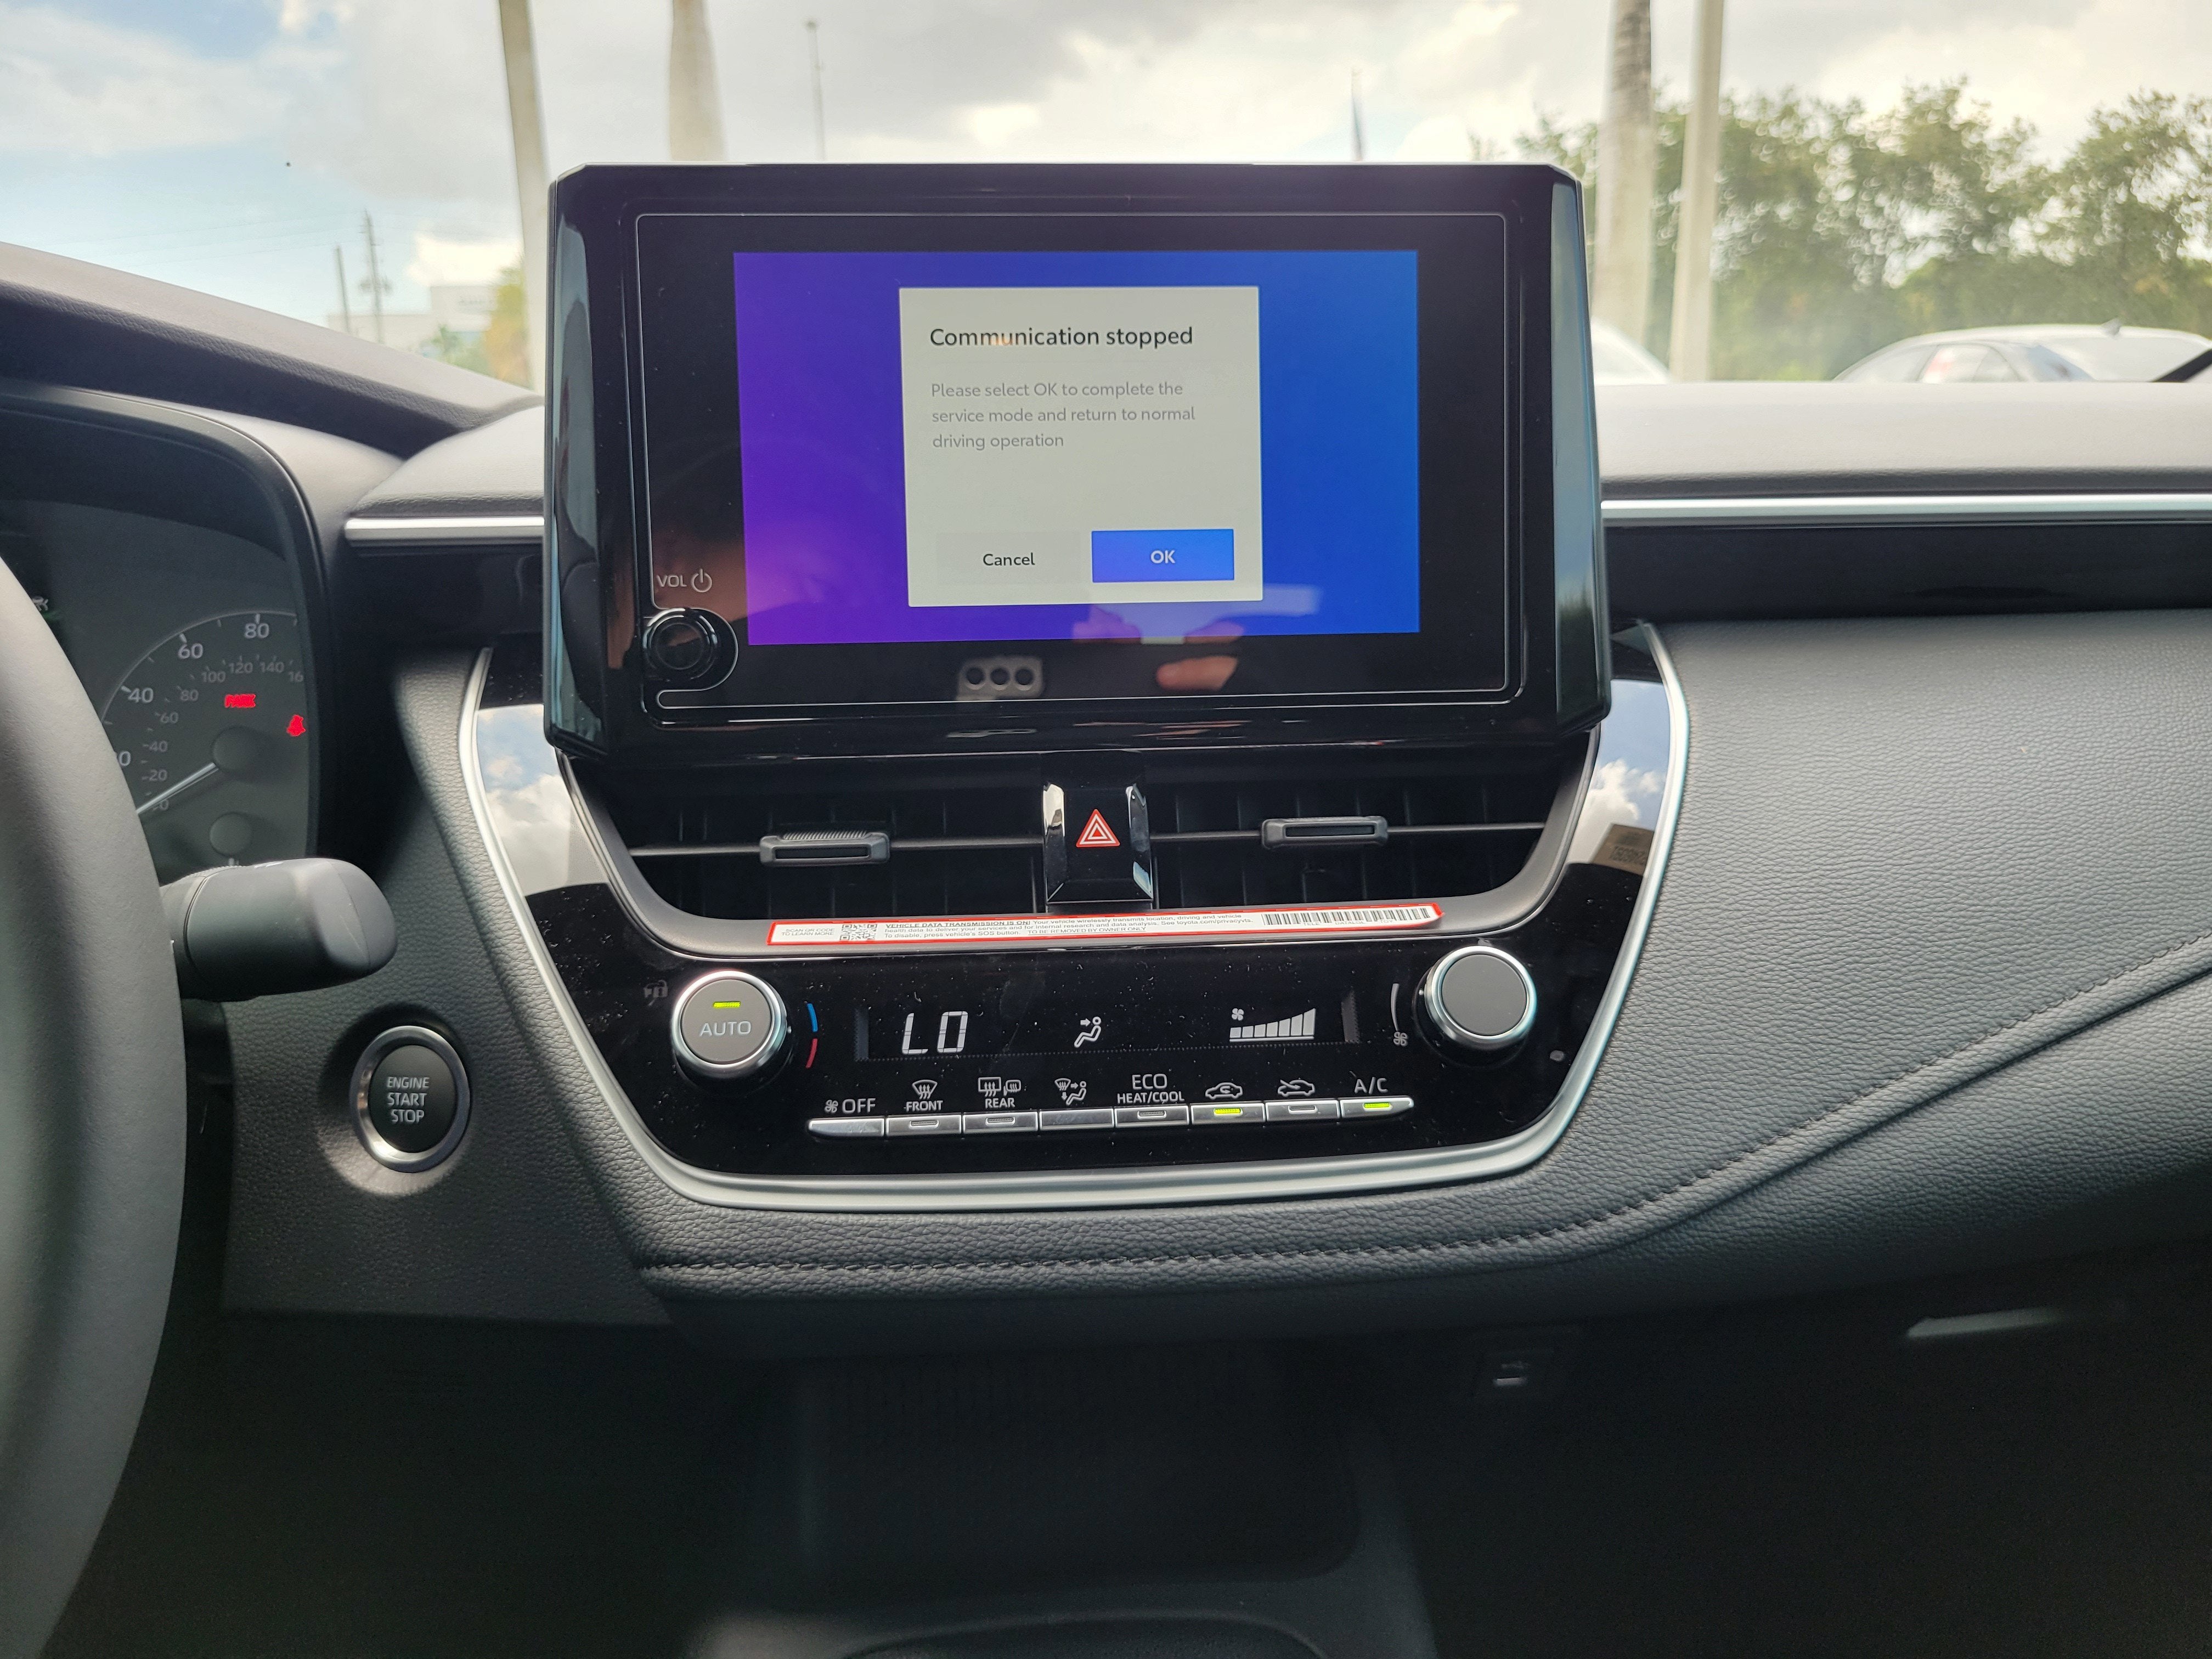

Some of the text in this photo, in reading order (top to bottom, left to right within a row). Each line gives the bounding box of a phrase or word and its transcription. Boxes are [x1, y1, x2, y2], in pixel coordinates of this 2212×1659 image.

[930, 326, 1193, 348] Communication stopped
[932, 382, 1183, 399] Please select OK to complete the
[932, 407, 1195, 422] service mode and return to normal
[933, 435, 1064, 450] driving operation
[983, 553, 1036, 567] Cancel
[1150, 550, 1175, 565] OK
[657, 574, 687, 588] VOL
[245, 623, 269, 639] 80
[178, 643, 204, 659] 60
[229, 662, 253, 674] 120
[259, 661, 285, 673] 140
[201, 671, 226, 683] 100
[128, 687, 154, 703] 40
[180, 689, 199, 702] 80
[160, 712, 179, 724] 60
[149, 741, 168, 752] 40
[149, 769, 168, 781] 20
[699, 1020, 752, 1037] AUTO
[902, 1011, 968, 1055] LO
[386, 1076, 430, 1090] ENGINE
[1131, 1073, 1168, 1090] ECO
[1354, 1077, 1389, 1094] A/C
[387, 1092, 427, 1107] START
[984, 1097, 1015, 1109] REAR
[1117, 1091, 1185, 1104] HEAT/COOL
[842, 1098, 876, 1114] OFF
[906, 1100, 944, 1113] FRONT
[390, 1109, 425, 1124] STOP
